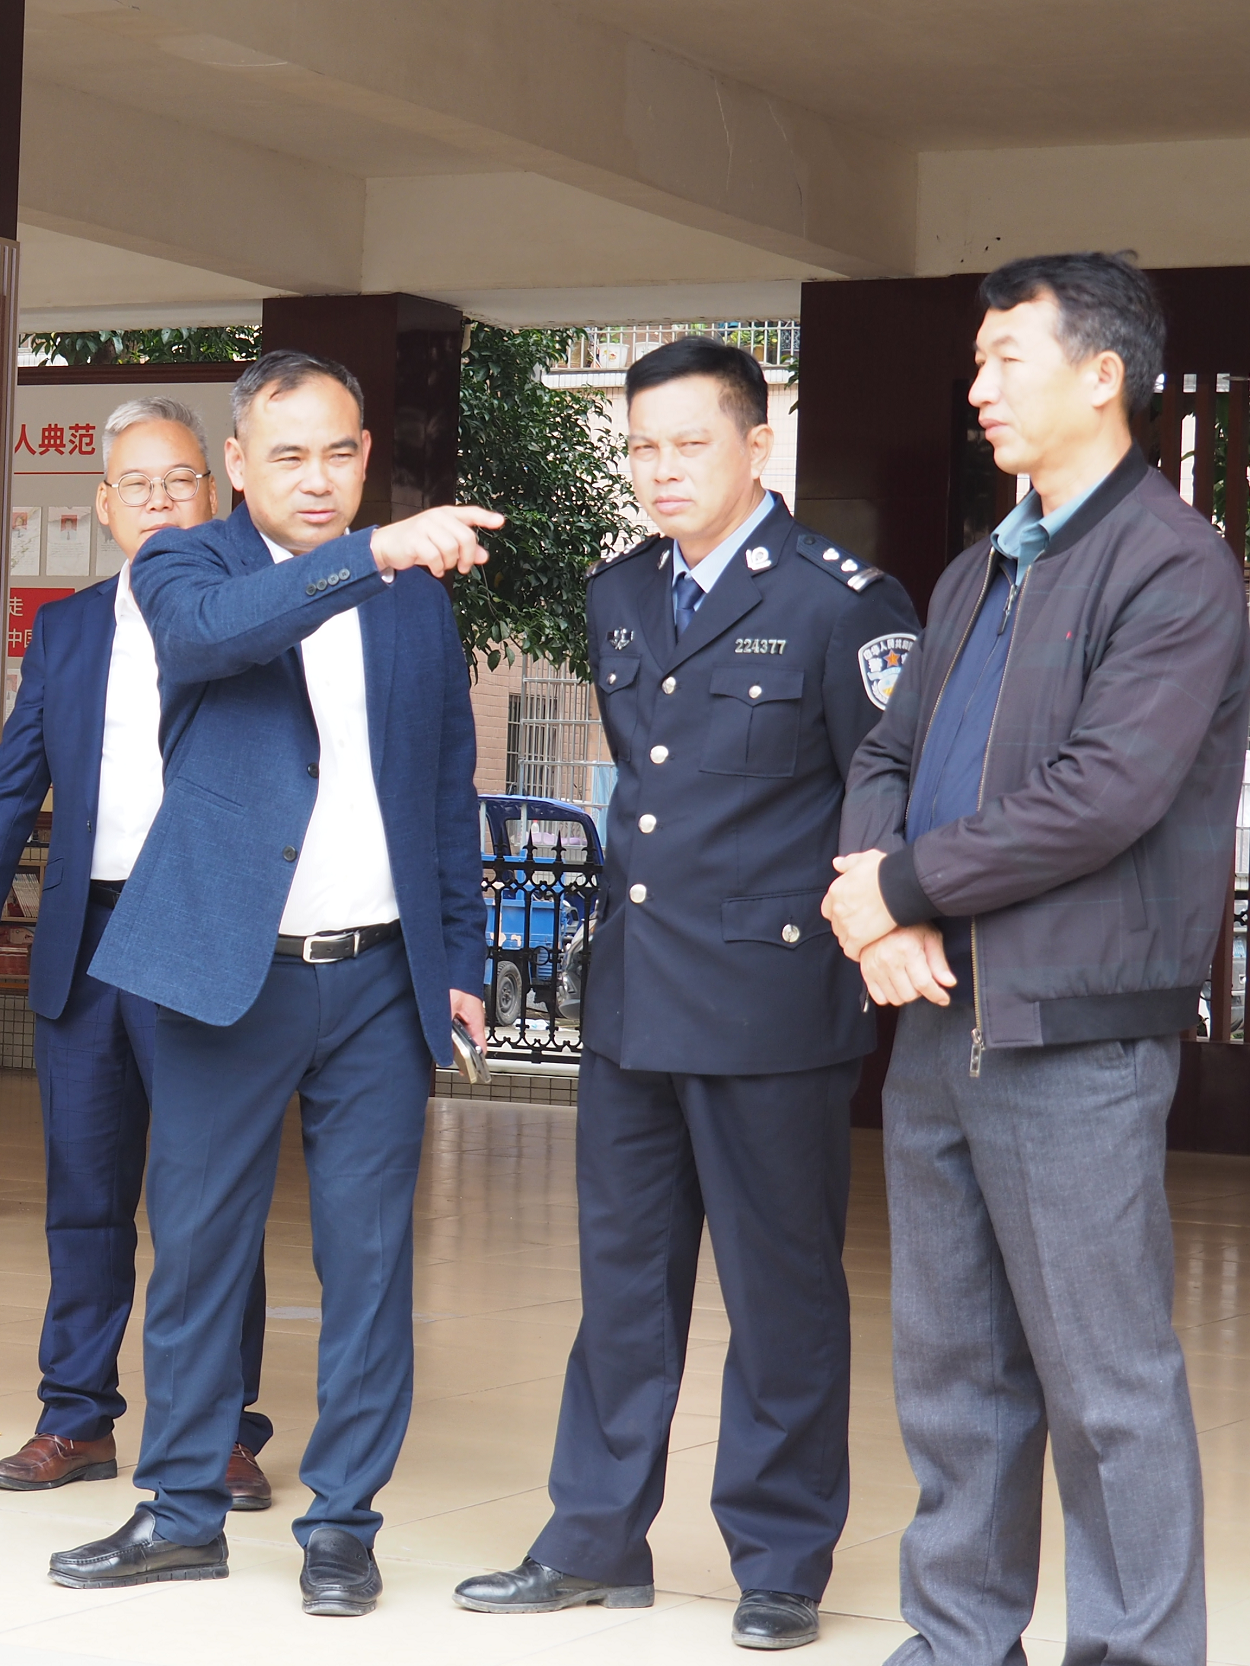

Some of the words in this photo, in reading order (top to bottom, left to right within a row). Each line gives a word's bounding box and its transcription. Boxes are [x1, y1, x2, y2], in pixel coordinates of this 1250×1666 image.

[14, 422, 96, 456] 人典范
[735, 638, 787, 655] 224377
